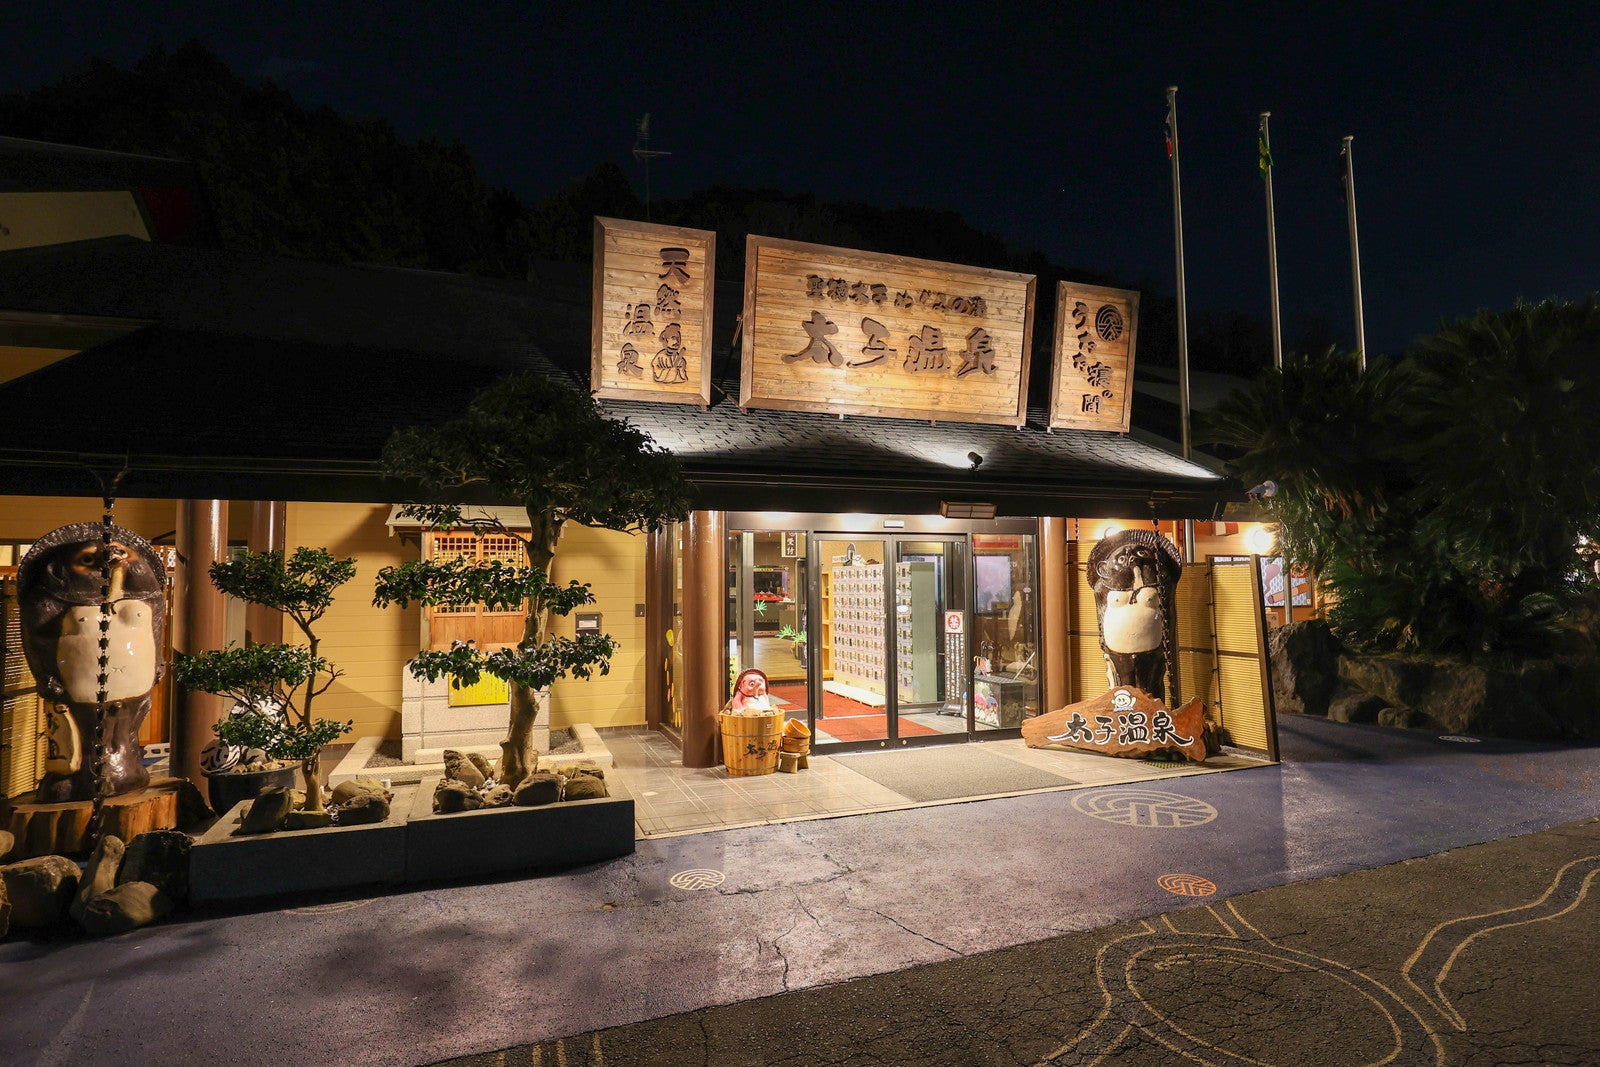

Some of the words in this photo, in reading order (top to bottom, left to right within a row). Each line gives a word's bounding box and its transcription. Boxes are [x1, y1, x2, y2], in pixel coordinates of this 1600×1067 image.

[654, 247, 691, 320] 天然
[617, 303, 655, 377] 温泉
[781, 310, 997, 378] 太子温泉
[1047, 711, 1194, 748] 太子温泉
